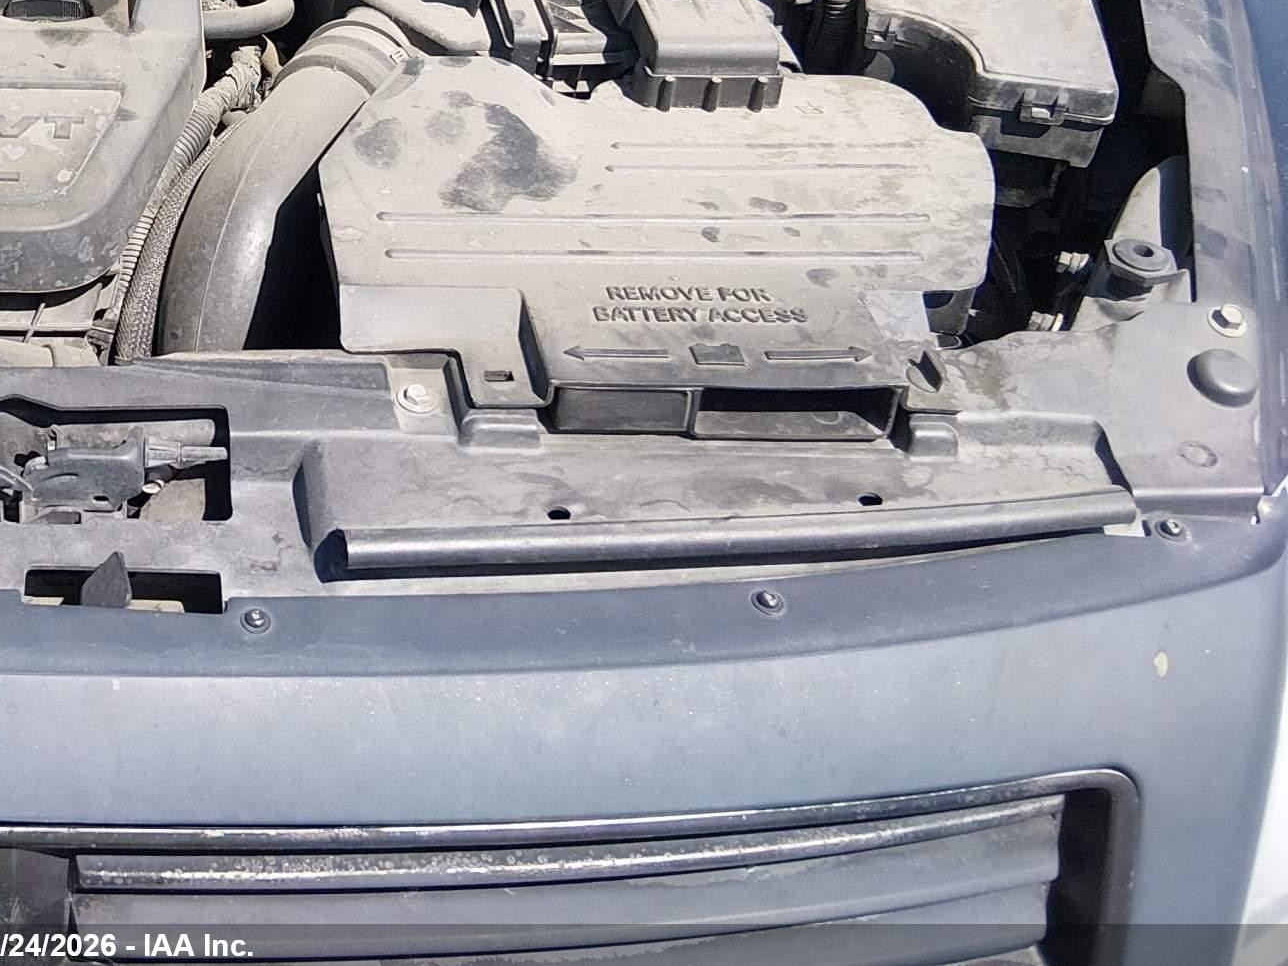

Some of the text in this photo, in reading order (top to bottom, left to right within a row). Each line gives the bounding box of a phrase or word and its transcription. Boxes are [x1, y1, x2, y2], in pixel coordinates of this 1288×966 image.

[605, 286, 773, 302] REMOVE FOR
[592, 305, 809, 323] BATTERY ACCESS
